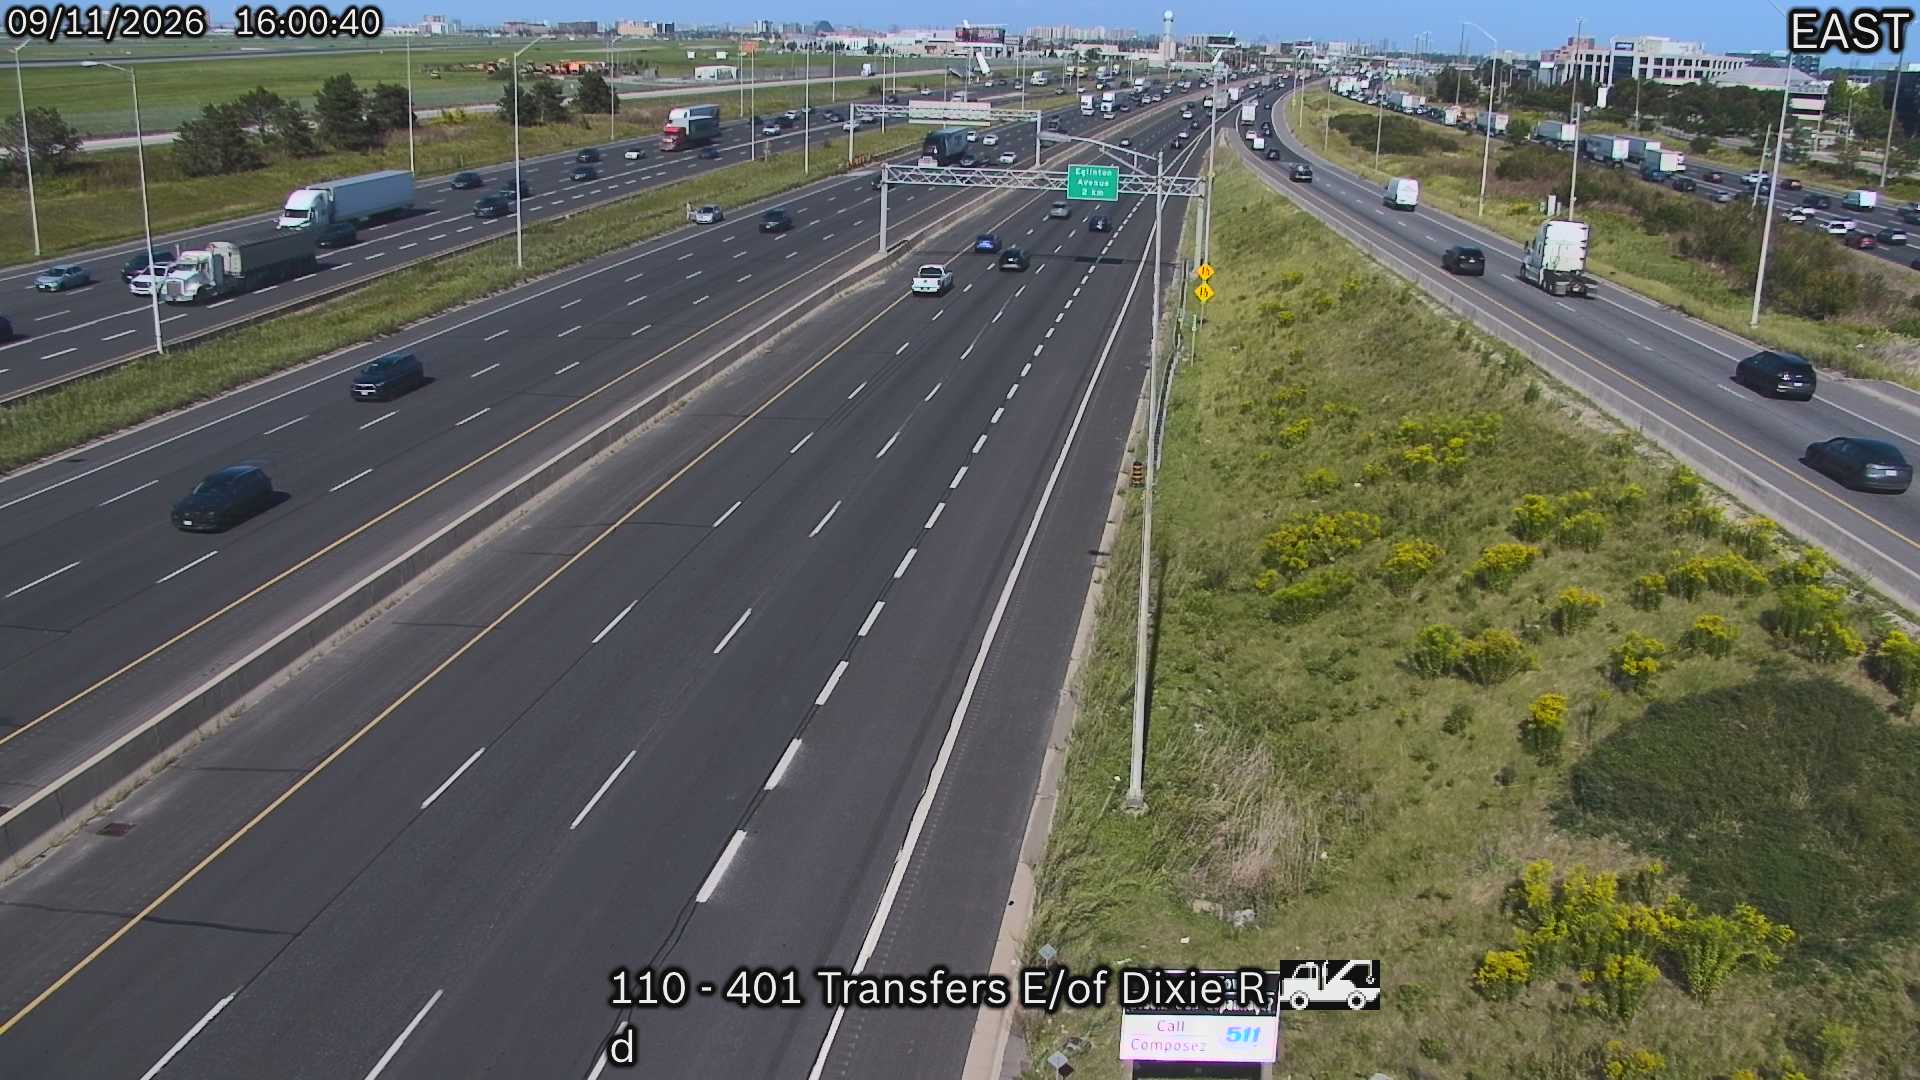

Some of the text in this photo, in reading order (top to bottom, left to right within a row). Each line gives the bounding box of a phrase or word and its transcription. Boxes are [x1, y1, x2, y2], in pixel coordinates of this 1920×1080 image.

[1075, 168, 1112, 177] Eglinton
[1077, 178, 1109, 187] Avenue
[1081, 188, 1104, 196] 2 km
[1157, 1020, 1185, 1032] Call
[1226, 1025, 1261, 1043] 511
[1131, 1038, 1207, 1052] Composez
